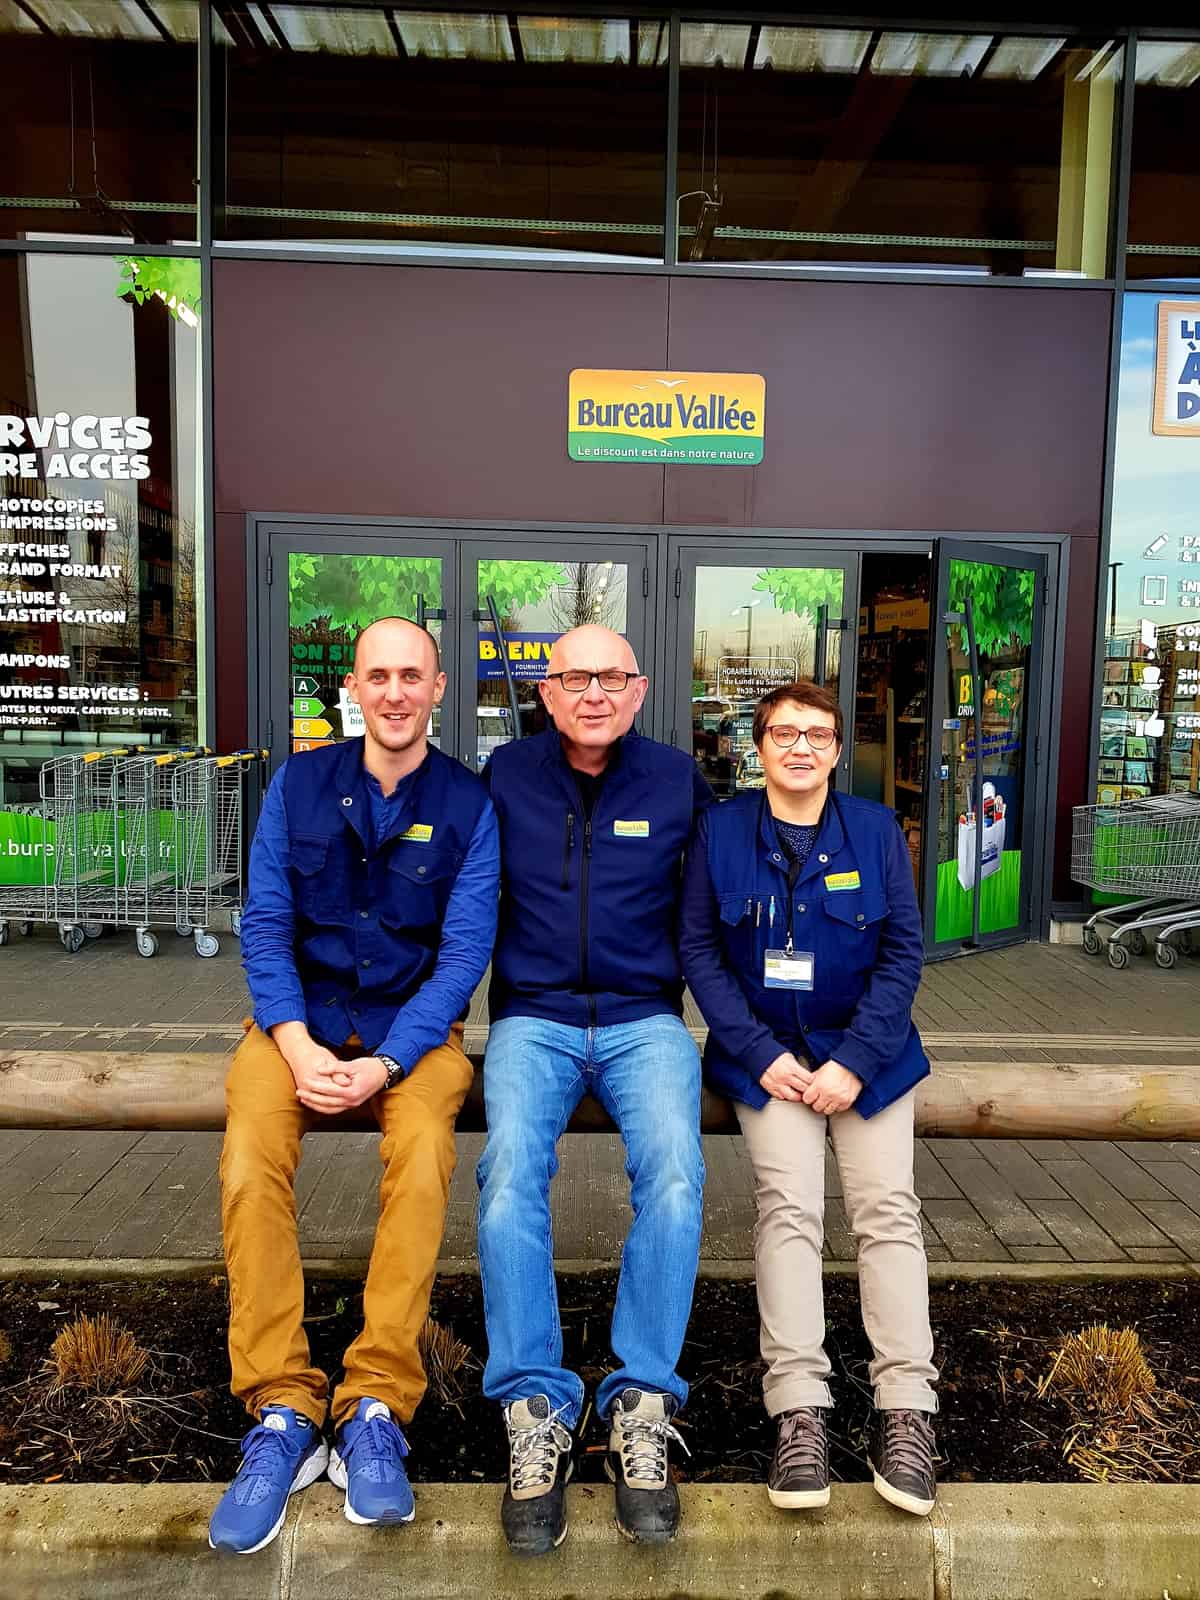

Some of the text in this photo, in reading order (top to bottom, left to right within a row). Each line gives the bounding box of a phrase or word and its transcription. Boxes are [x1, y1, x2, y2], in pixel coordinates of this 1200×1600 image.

[576, 393, 757, 431] Bureau Vallée
[577, 446, 756, 460] Le discount est dans notre nature
[49, 563, 122, 579] FORMAT
[60, 591, 72, 606] &
[293, 644, 323, 660] ON
[292, 663, 324, 675] POUR
[1178, 668, 1200, 681] SH
[298, 680, 309, 693] A
[0, 704, 27, 713] RTES
[28, 705, 42, 714] DE
[81, 706, 121, 716] CARTES
[122, 707, 135, 716] DE
[300, 701, 310, 712] B
[299, 721, 312, 734] C
